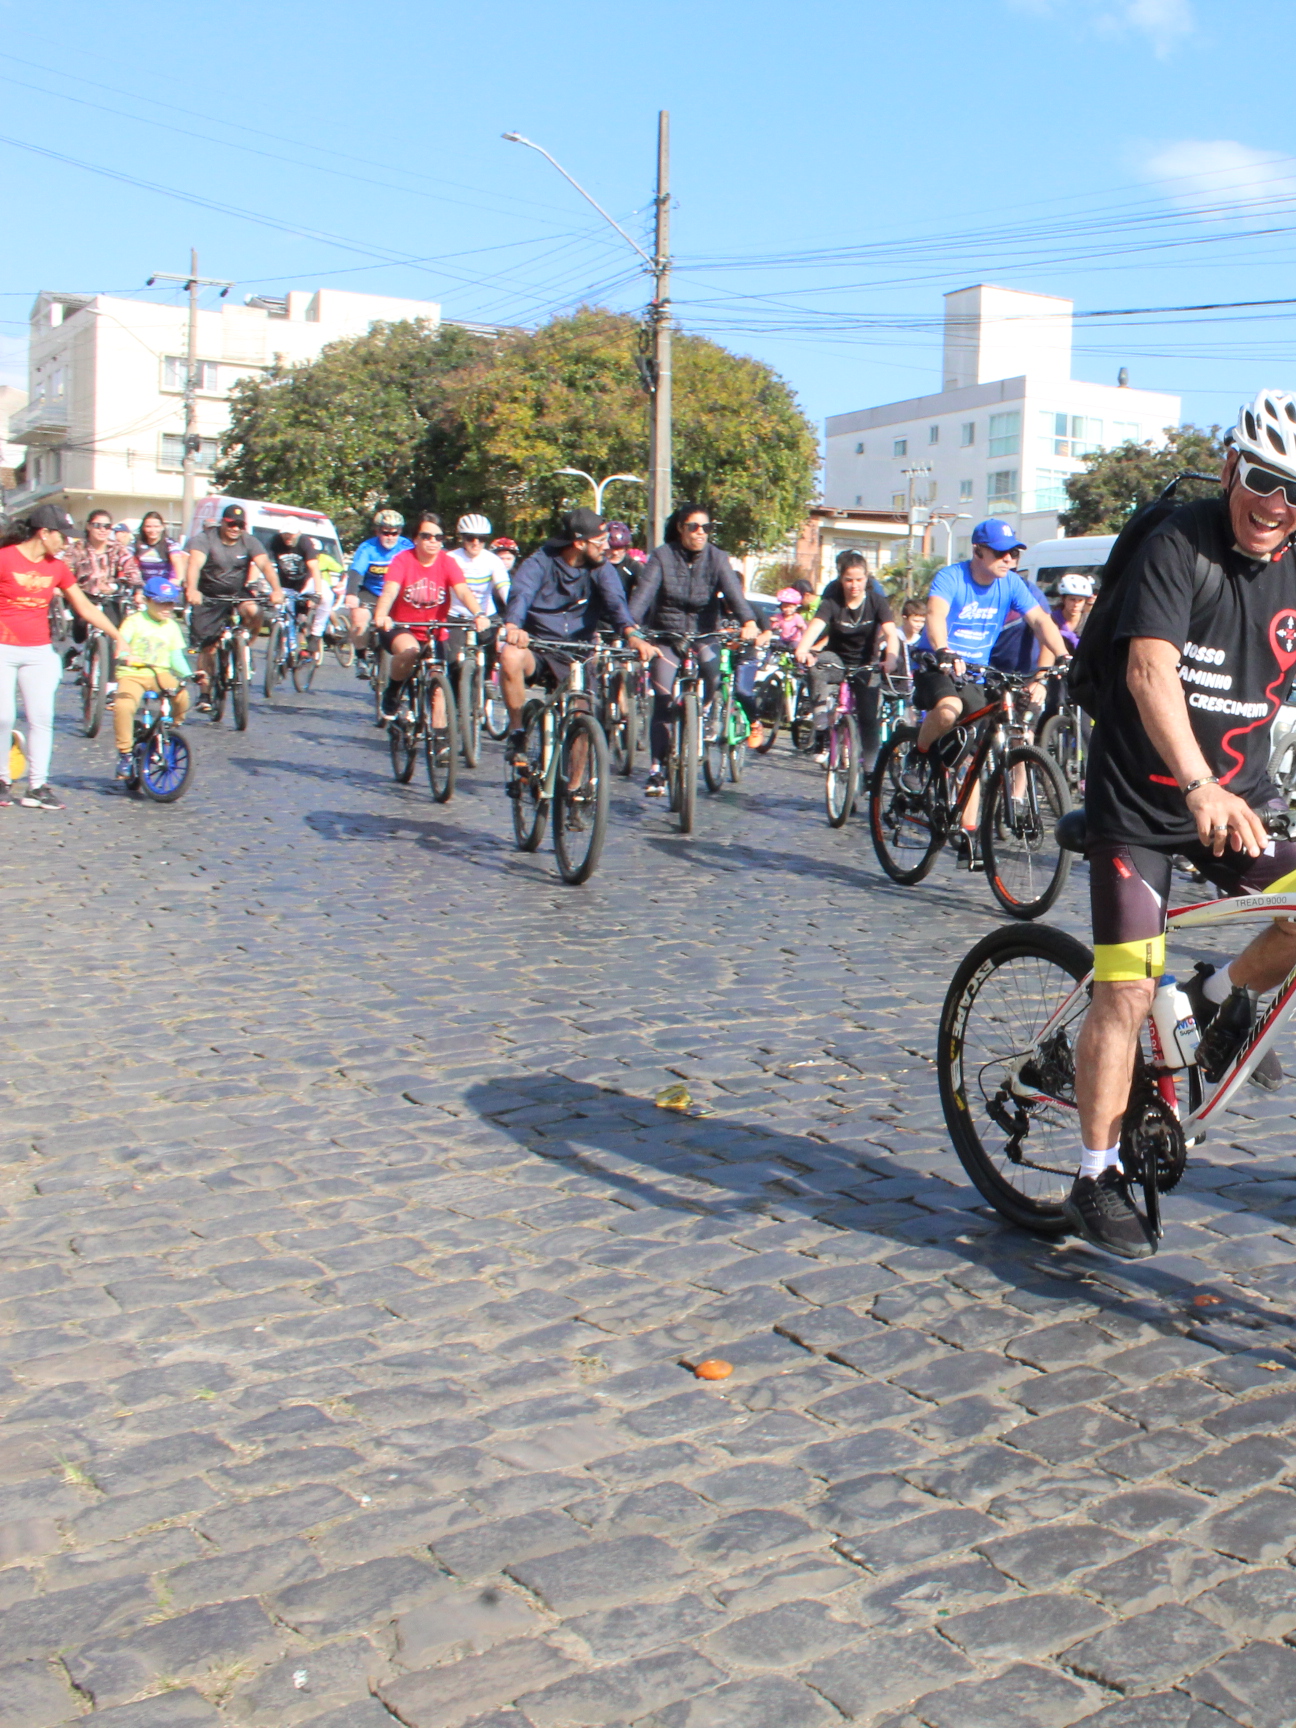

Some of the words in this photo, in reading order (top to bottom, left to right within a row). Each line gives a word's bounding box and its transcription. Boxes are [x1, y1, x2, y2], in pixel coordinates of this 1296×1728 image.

[1176, 662, 1232, 691] AMINHO
[1189, 692, 1268, 718] CRESCIMENTO
[1235, 897, 1265, 907] TREAD
[1266, 896, 1287, 906] 9000
[952, 958, 996, 1040] ESCAPE
